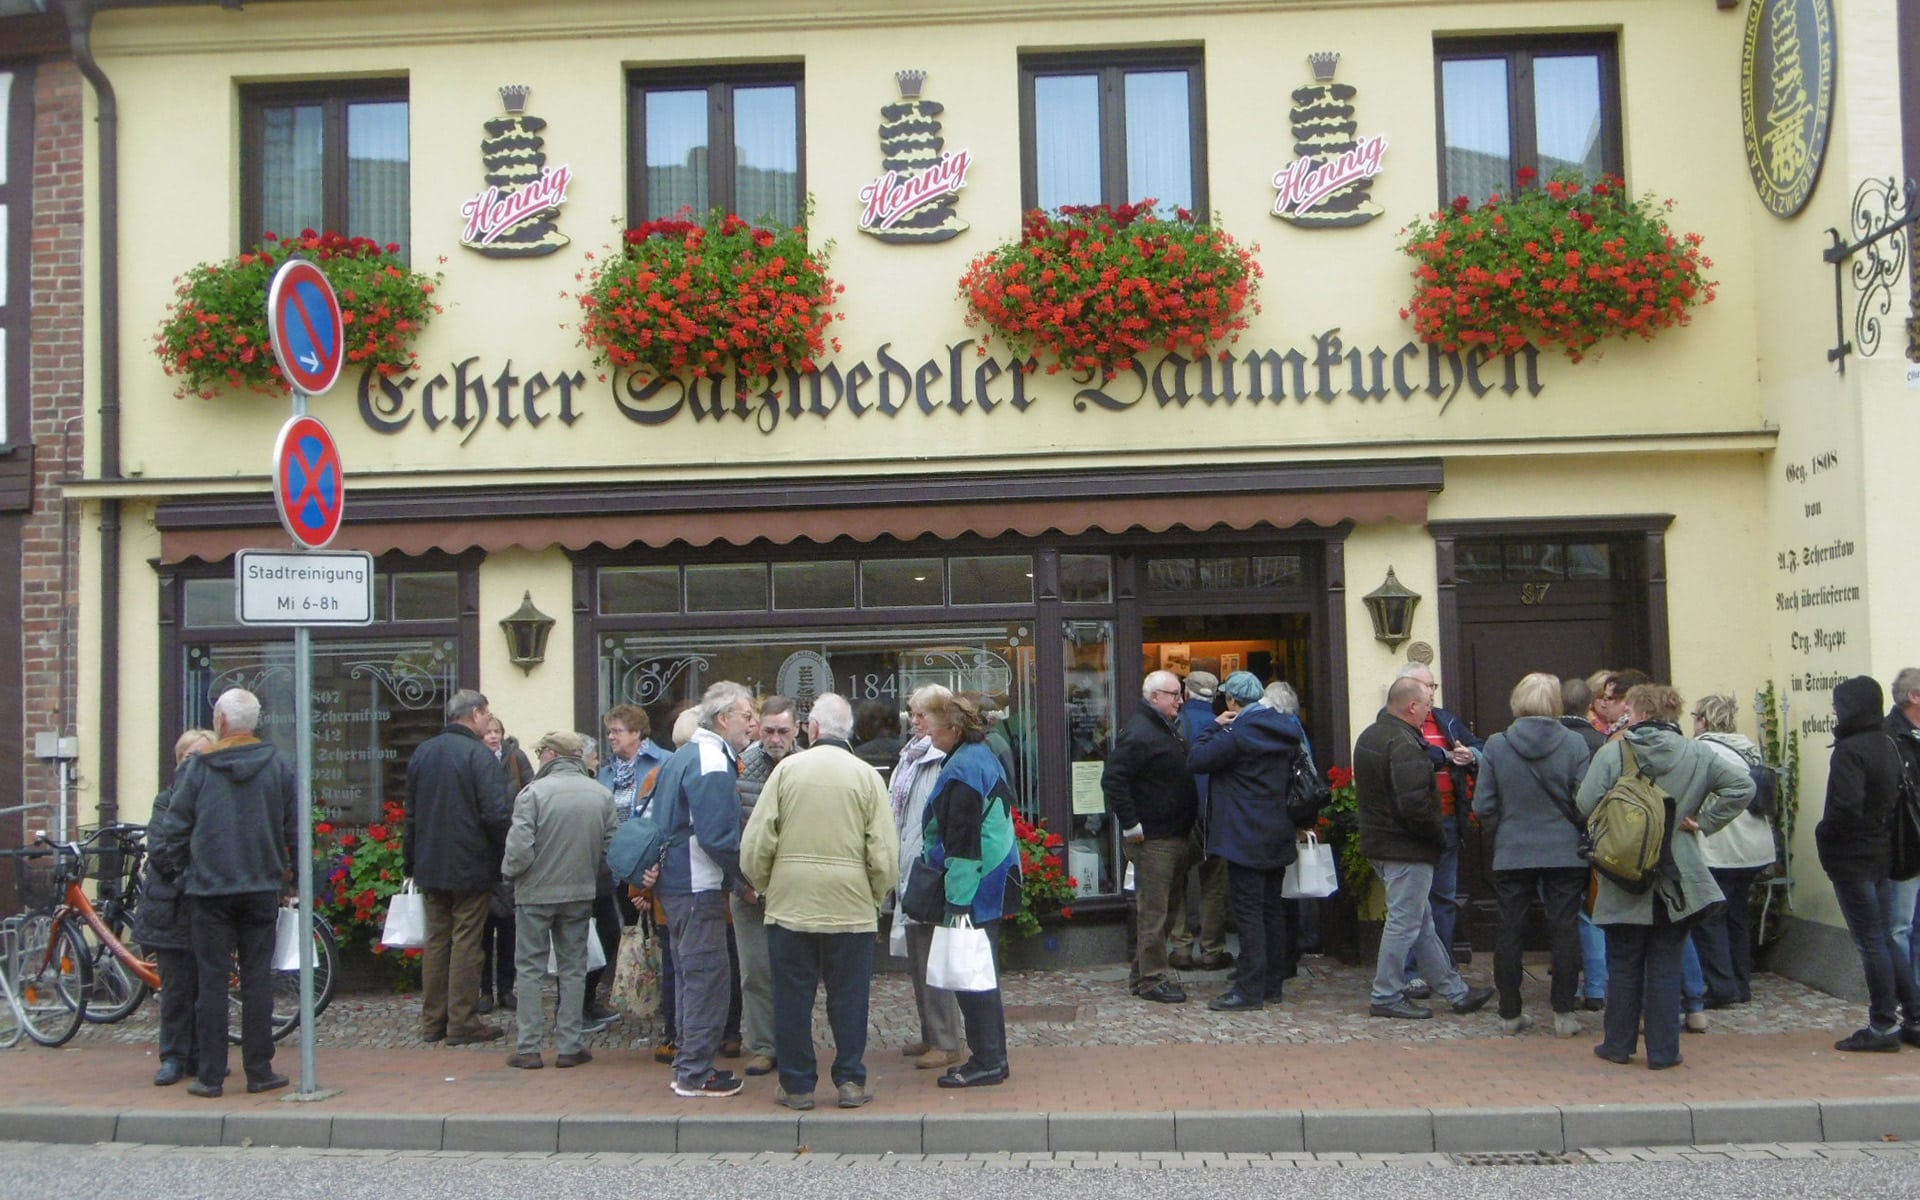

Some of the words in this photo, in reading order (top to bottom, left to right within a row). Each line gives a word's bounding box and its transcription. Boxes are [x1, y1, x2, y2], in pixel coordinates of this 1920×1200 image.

[1742, 0, 1761, 136] SCHERNIKO
[860, 150, 971, 226] Hennig
[1273, 136, 1386, 213] Hennig
[1760, 151, 1819, 213] SALZWEDEL
[462, 166, 571, 241] Hennig
[358, 356, 586, 447] Echter
[1812, 450, 1838, 474] 1808
[1805, 502, 1821, 518] von
[249, 566, 363, 583] Stadtreinigung
[277, 597, 295, 610] Mi
[1776, 591, 1798, 612] Nach
[1802, 585, 1859, 607] überliefertem
[1791, 631, 1811, 655] Org.
[1814, 627, 1845, 653] Rezept
[1792, 673, 1802, 691] im
